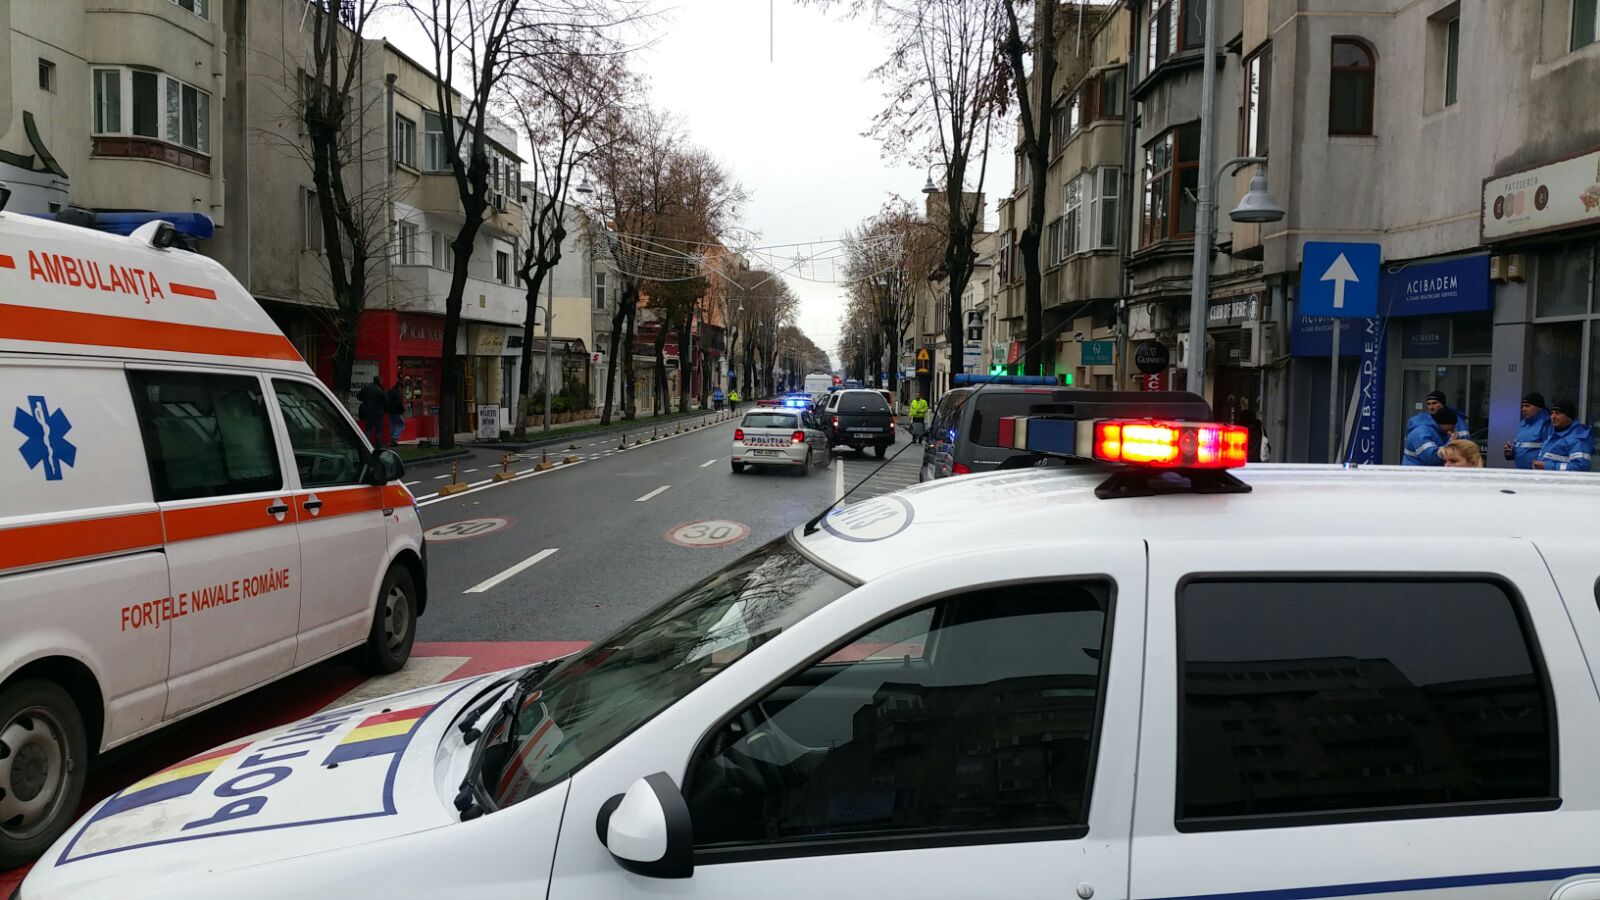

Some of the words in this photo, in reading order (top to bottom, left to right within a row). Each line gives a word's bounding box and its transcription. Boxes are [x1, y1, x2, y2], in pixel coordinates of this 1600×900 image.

[1406, 275, 1458, 295] ACIBADEM
[432, 521, 497, 536] 50
[683, 524, 733, 539] 30
[192, 580, 240, 613] NAVALE
[243, 567, 290, 599] ROMÂNE
